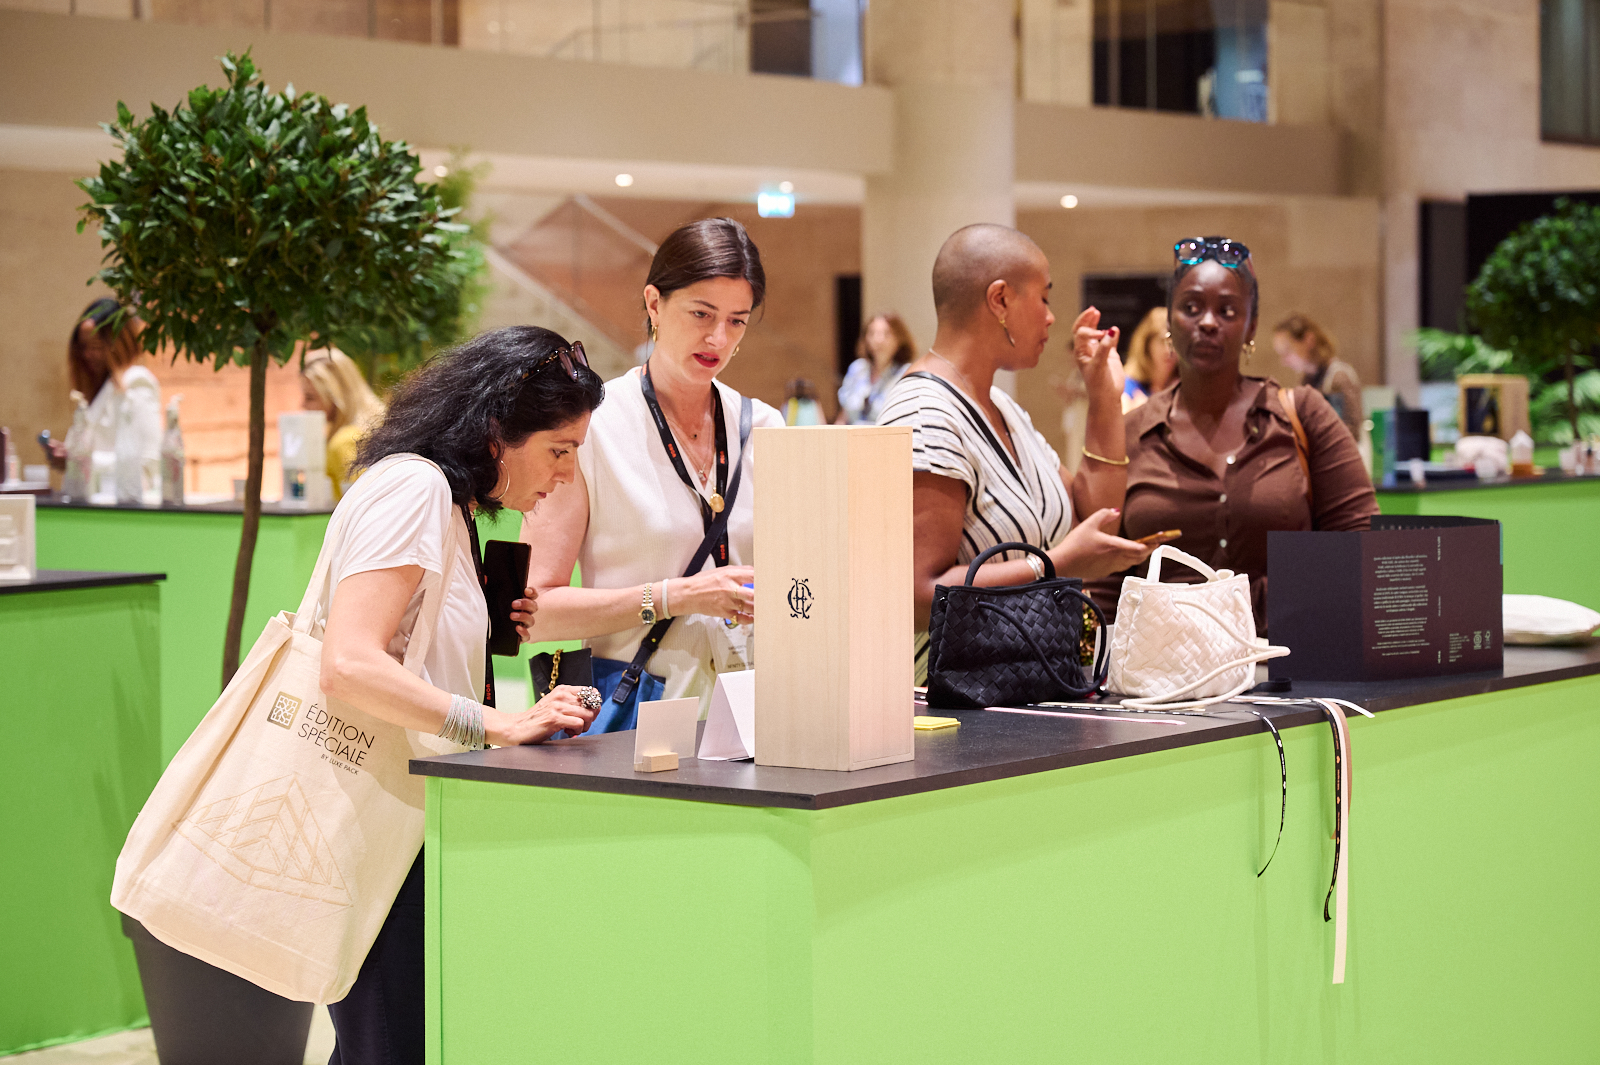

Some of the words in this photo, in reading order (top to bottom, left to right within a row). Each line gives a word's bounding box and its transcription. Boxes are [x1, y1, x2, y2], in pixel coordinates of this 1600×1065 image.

[297, 723, 367, 767] SPÉCIALE
[305, 703, 375, 749] ÉDITION
[320, 753, 328, 761] BY
[329, 758, 343, 768] LUXE
[343, 765, 359, 776] PACK
